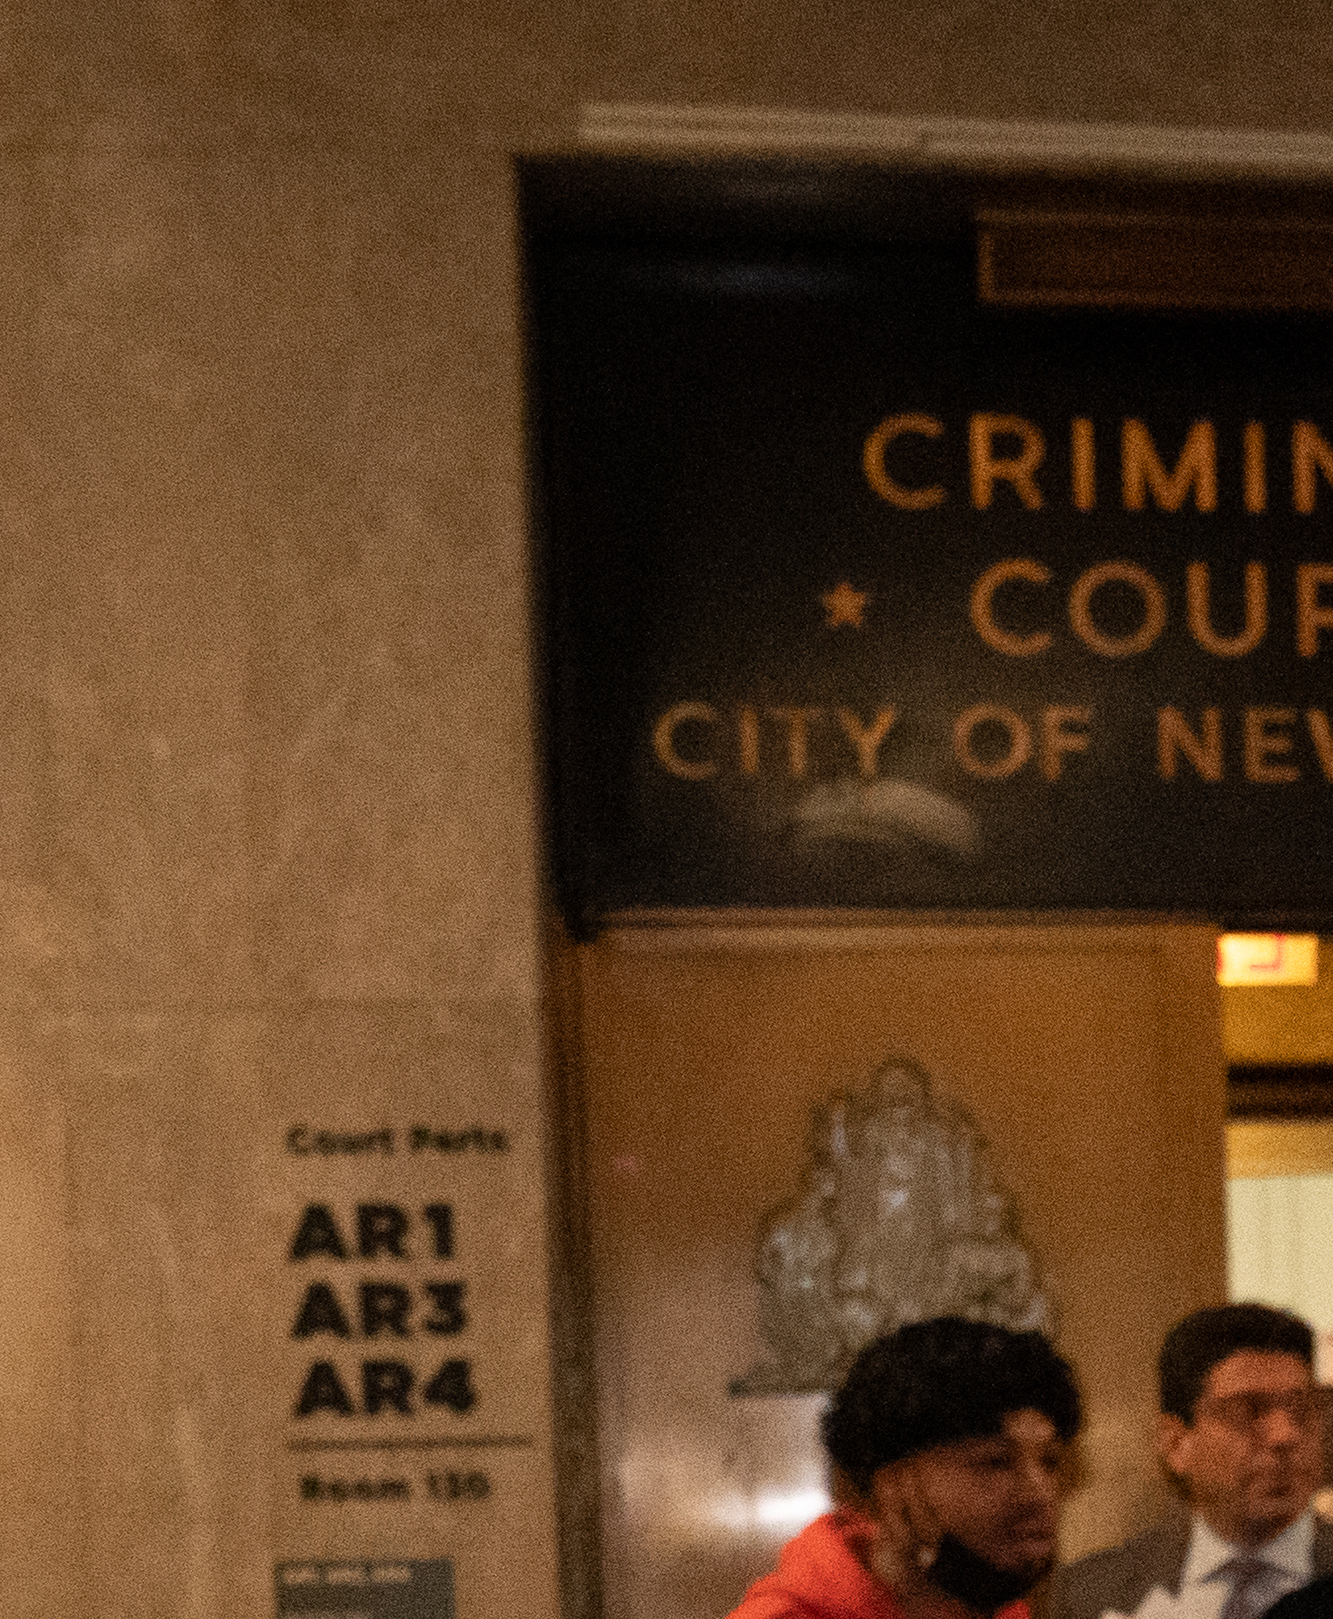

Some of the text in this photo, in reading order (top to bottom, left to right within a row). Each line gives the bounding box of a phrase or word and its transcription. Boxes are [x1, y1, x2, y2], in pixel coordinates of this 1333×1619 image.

[651, 701, 898, 781] CITY
[953, 703, 1094, 783] OF
[287, 1122, 511, 1156] Court Parts
[292, 1204, 453, 1259] AR1
[293, 1281, 466, 1338] AR3
[296, 1359, 476, 1416] AR4
[300, 1472, 411, 1503] Room
